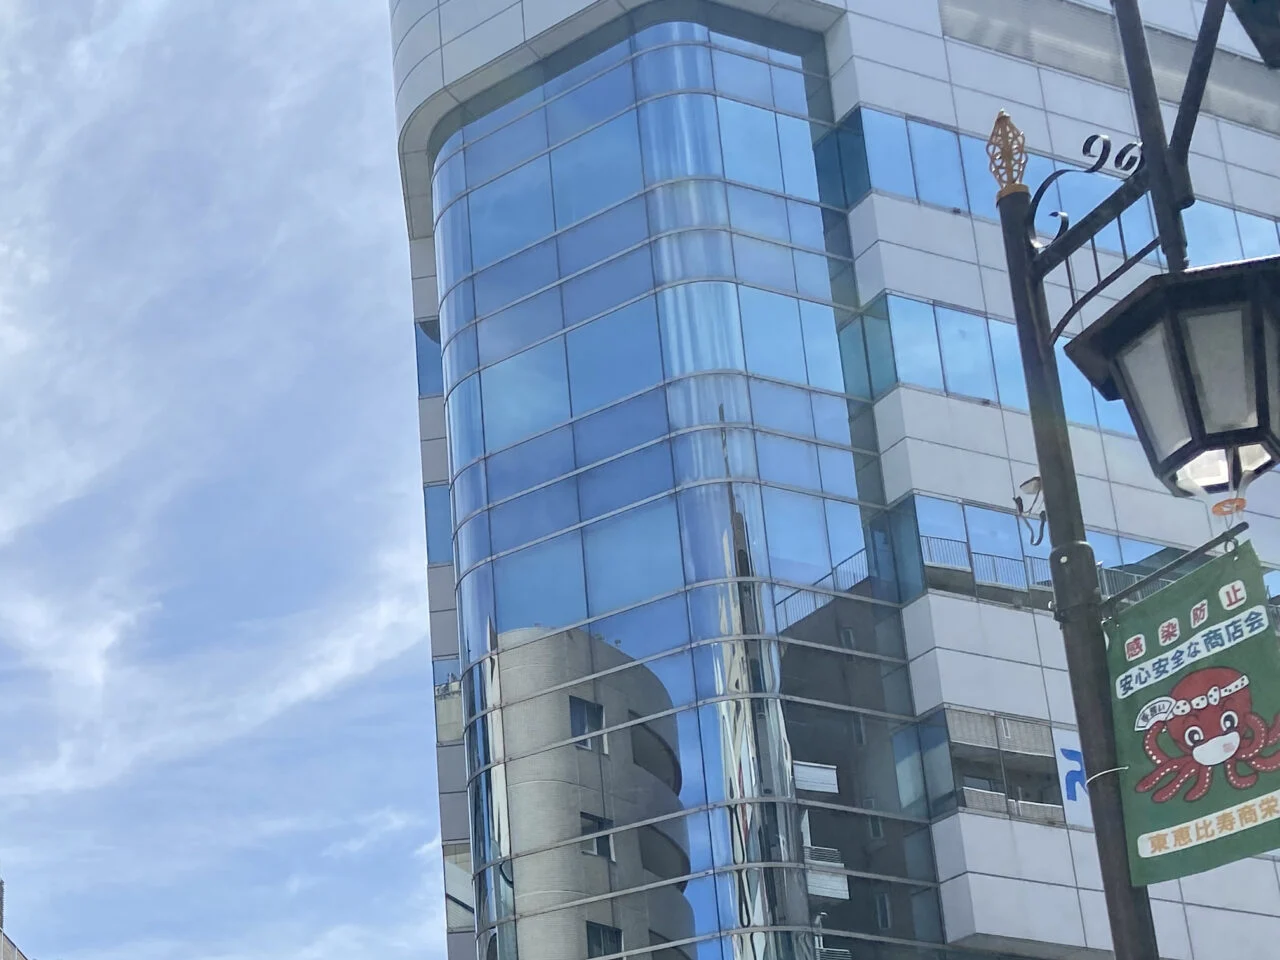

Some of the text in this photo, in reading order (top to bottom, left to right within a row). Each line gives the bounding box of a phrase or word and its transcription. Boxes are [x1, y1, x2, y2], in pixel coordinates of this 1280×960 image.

[1119, 610, 1265, 697] 安心安全な商店会
[1126, 584, 1245, 660] 感染防止
